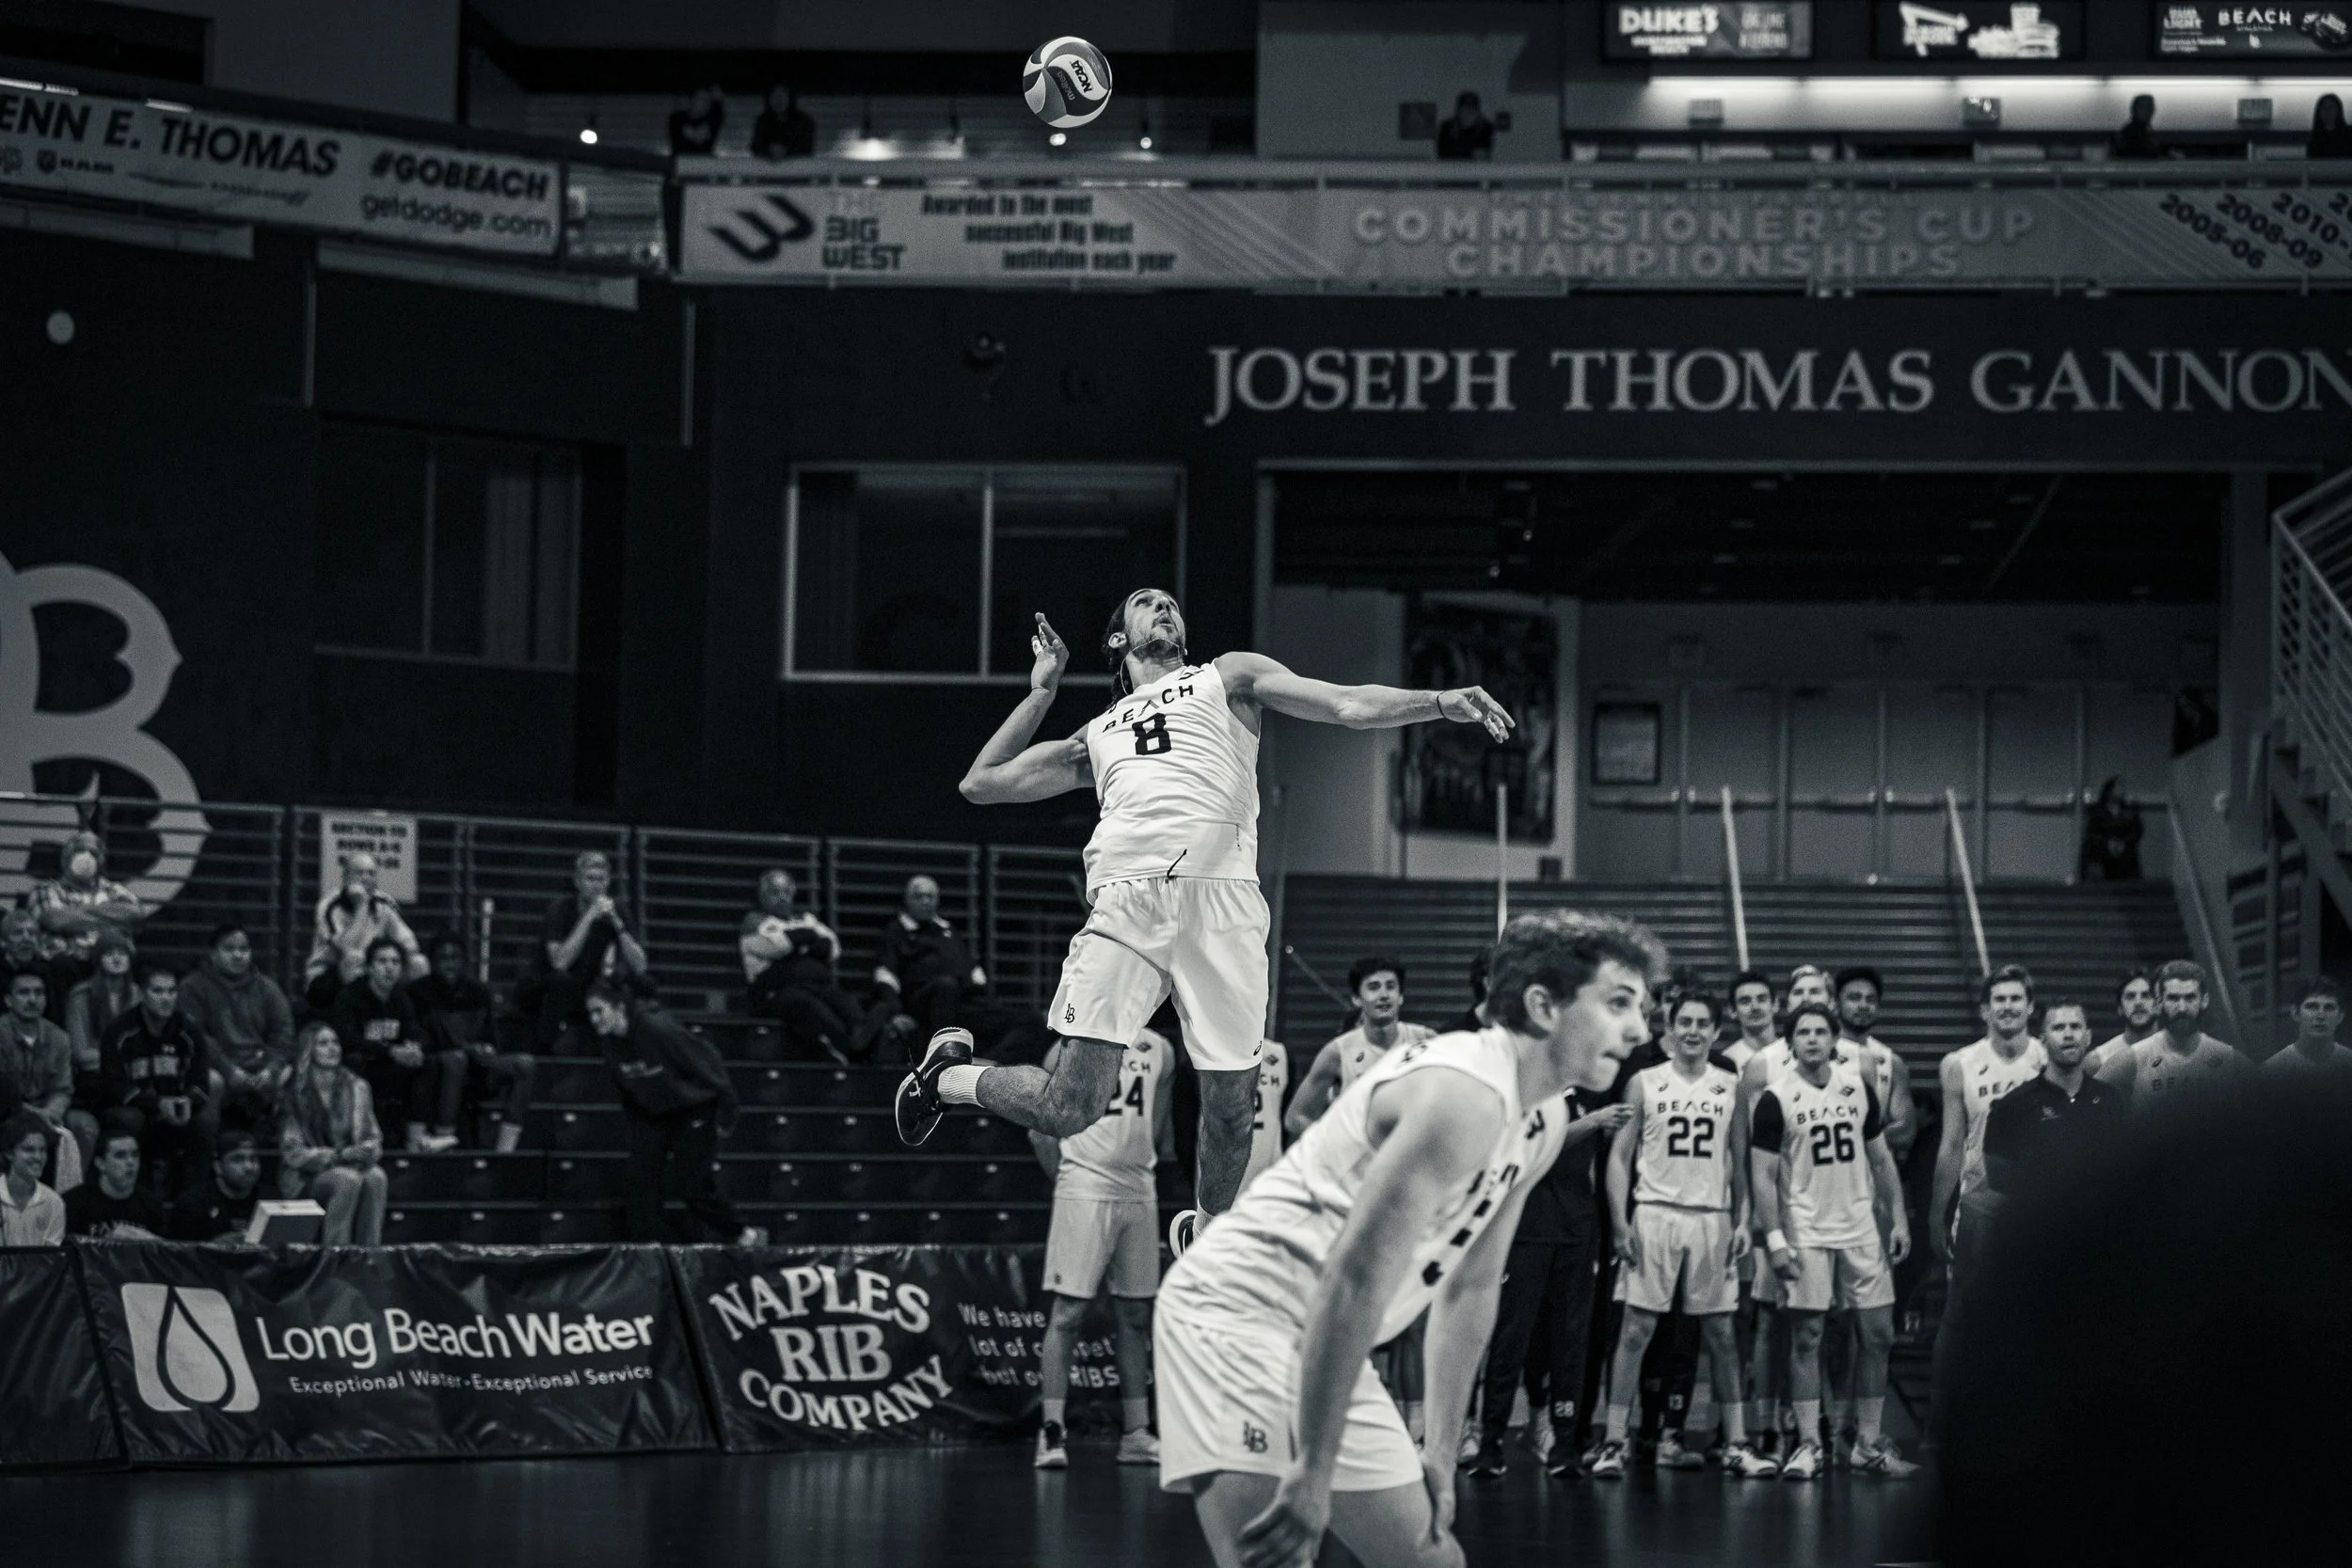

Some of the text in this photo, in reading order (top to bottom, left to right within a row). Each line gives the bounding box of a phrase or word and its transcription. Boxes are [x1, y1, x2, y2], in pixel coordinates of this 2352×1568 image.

[2218, 6, 2292, 26] BEACH
[1057, 70, 1075, 101] molten
[1071, 59, 1093, 92] NCAA
[103, 109, 140, 150] E.
[162, 117, 340, 178] THOMAS
[371, 150, 549, 202] #GOBEACH
[359, 193, 550, 239] getdodge.com
[922, 194, 994, 215] Awarded
[1021, 195, 1048, 215] the
[1053, 196, 1091, 215] most
[827, 215, 880, 242] BIG
[964, 219, 1133, 245] successful Big West
[1354, 206, 2034, 245] COMMISSIONER'S CUP
[2159, 193, 2265, 269] 2005-06
[2217, 193, 2323, 269] 2008-09
[2271, 192, 2352, 261] 2010-
[822, 243, 904, 269] WEST
[1136, 253, 1176, 275] year
[1448, 244, 1959, 278] CHAMPIONSHIPS
[1203, 346, 1518, 426] JOSEPH
[1549, 346, 1937, 414] THOMAS
[1132, 712, 1171, 755] 8
[1657, 1100, 1724, 1117] BEACH
[1796, 1105, 1859, 1125] BEACH
[1668, 1117, 1715, 1159] 22
[1810, 1121, 1855, 1165] 26
[707, 1263, 931, 1342] NAPLES
[957, 1302, 1047, 1329] We have
[255, 1315, 378, 1370] Long
[769, 1322, 894, 1383] RIB
[967, 1333, 1002, 1357] lot
[1003, 1335, 1027, 1358] of
[289, 1370, 405, 1398] Exceptional
[582, 1363, 654, 1385] Service
[738, 1353, 954, 1432] COMPANY
